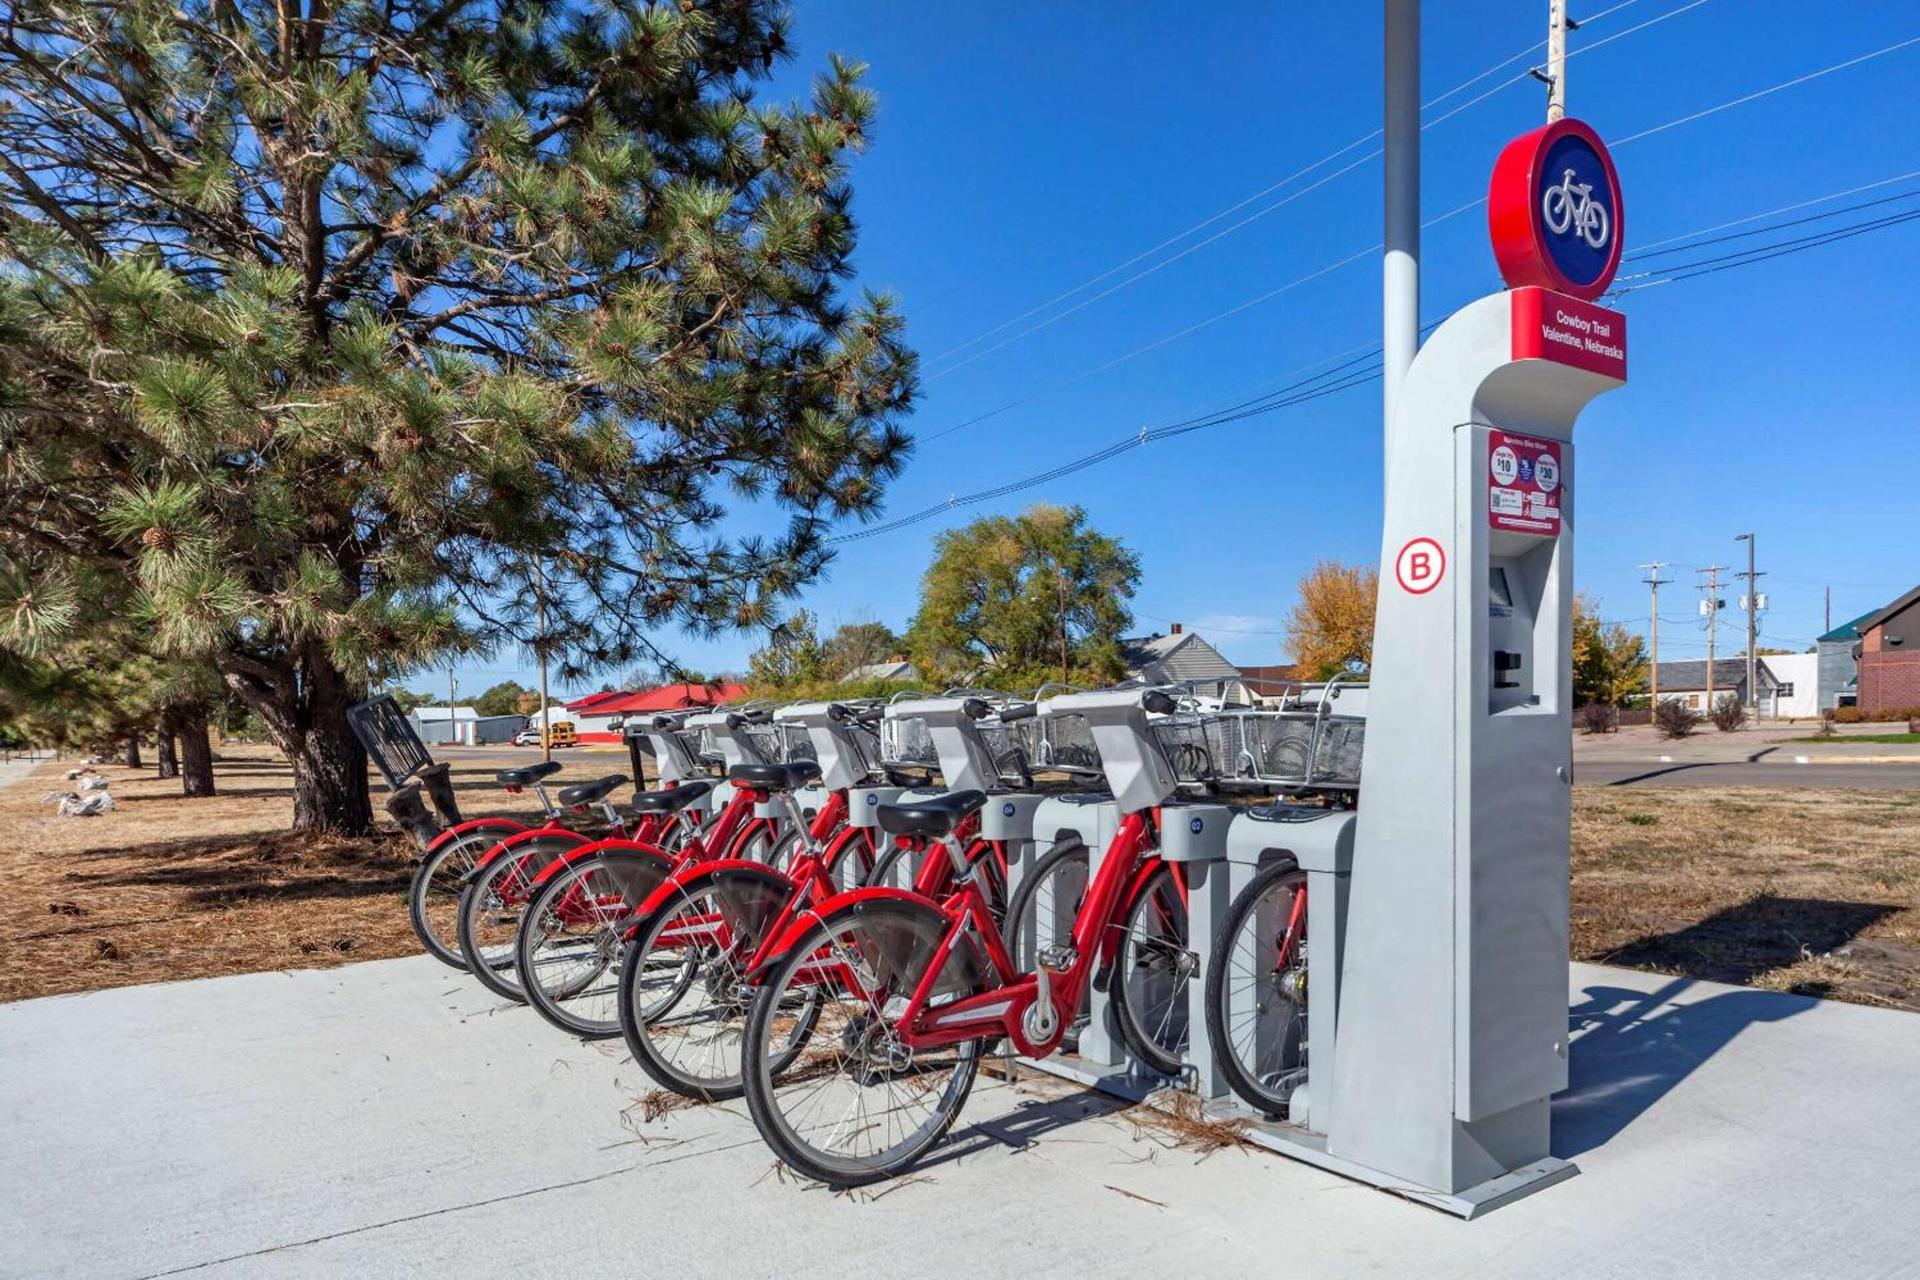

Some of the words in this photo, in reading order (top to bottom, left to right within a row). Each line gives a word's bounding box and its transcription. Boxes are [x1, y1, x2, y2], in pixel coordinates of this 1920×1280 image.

[1556, 310, 1592, 334] Cowboy
[1592, 320, 1610, 338] Trail
[1542, 324, 1583, 351] Valentine,
[1585, 338, 1624, 360] Nebraska
[1411, 552, 1431, 580] B
[1191, 820, 1201, 831] 02
